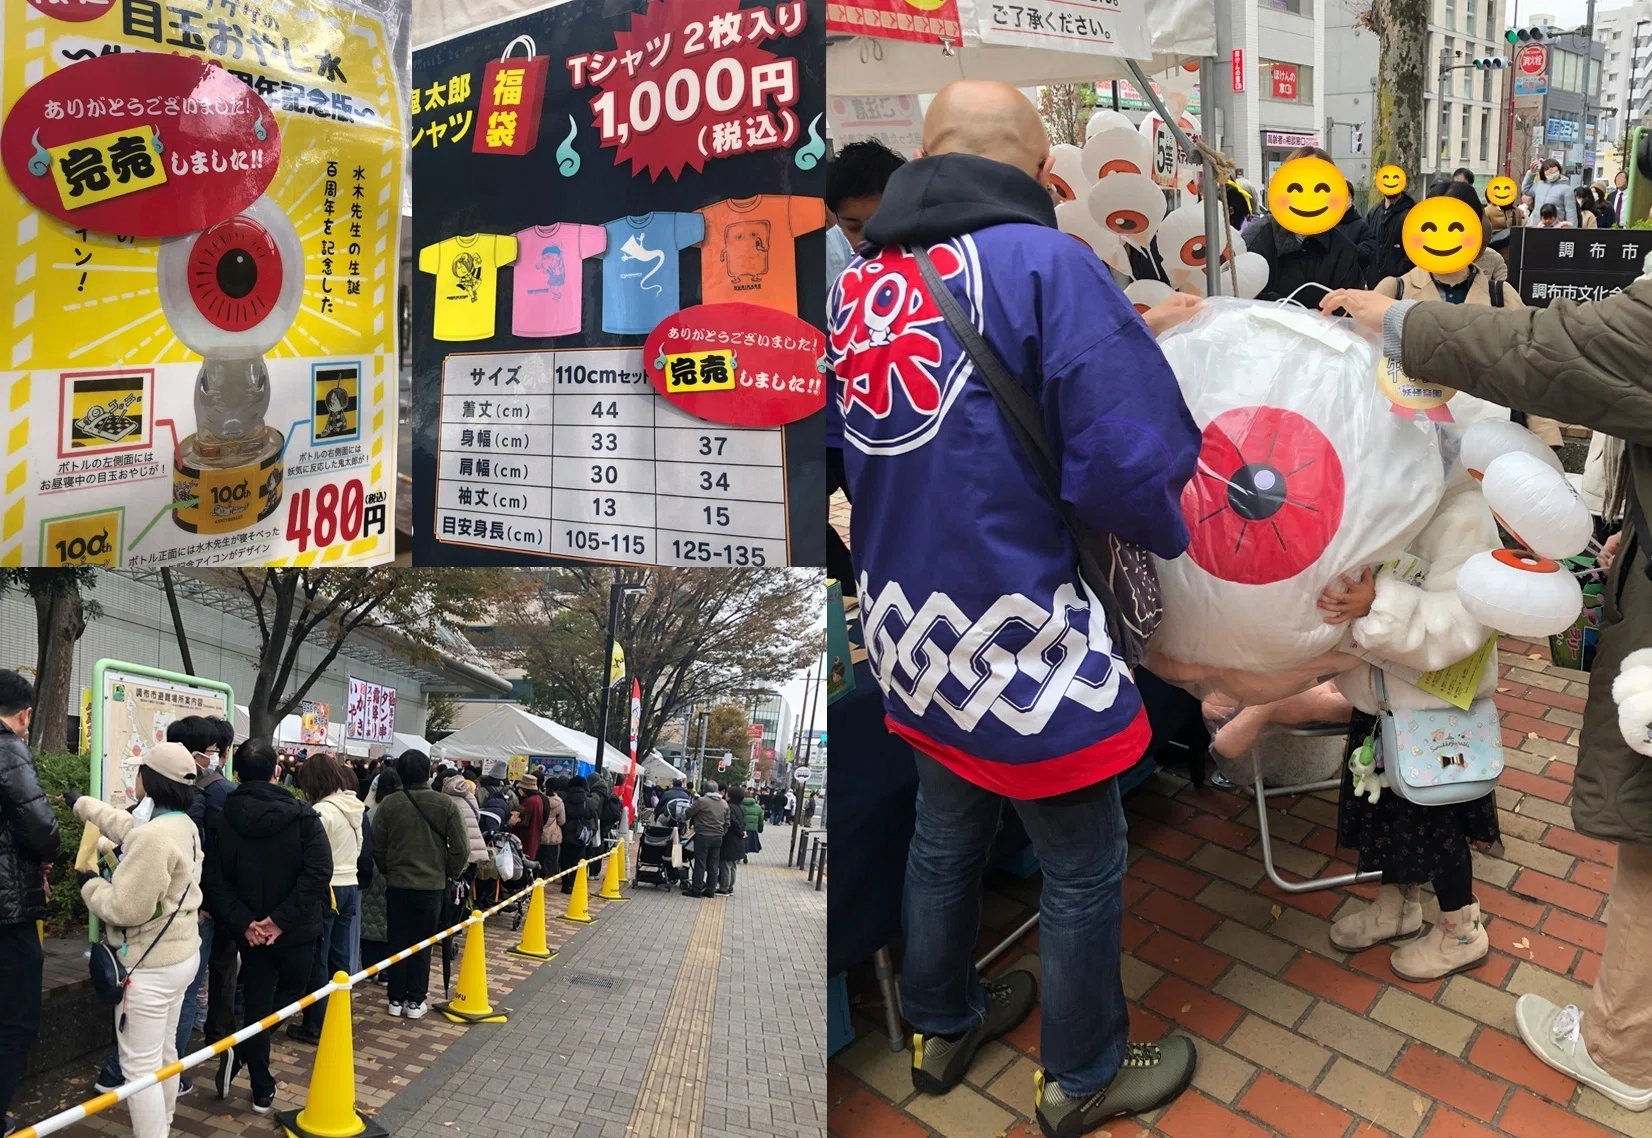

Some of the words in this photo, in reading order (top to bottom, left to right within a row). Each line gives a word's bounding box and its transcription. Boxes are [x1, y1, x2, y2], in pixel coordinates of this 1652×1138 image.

[992, 4, 1111, 39] ご了承ください。
[122, 0, 347, 84] 目玉おやじ水
[568, 32, 671, 85] Tシャツ
[683, 3, 802, 55] 2枚入り
[1273, 70, 1296, 82] ほけんの
[485, 68, 526, 148] 福袋
[592, 57, 795, 144] 1,000円
[697, 109, 795, 157] (税込)
[60, 136, 156, 197] 完売
[320, 161, 339, 313] 百周年を記念した
[347, 165, 366, 295] 水木先生の生誕
[1558, 241, 1639, 260] 調布市
[667, 326, 819, 351] ありがとうございました!
[470, 365, 523, 387] サイズ
[670, 354, 730, 387] 完売
[462, 400, 531, 419] 着丈(cm)
[591, 400, 619, 419] 44
[300, 445, 362, 461] ボトルの右側面には
[460, 429, 530, 449] 身幅(cm)
[591, 432, 618, 451] 33
[698, 436, 728, 456] 37
[40, 464, 166, 491] お昼寝中の目玉おやじが!
[58, 451, 154, 473] ボトルの左側面には
[459, 457, 529, 480] 肩幅(cm)
[590, 465, 618, 484] 30
[699, 471, 730, 492] 34
[458, 486, 528, 511] 袖丈(cm)
[592, 497, 617, 517] 13
[703, 505, 731, 526] 15
[442, 515, 544, 546] 目安身長(cm)
[565, 529, 646, 555] 105-115
[672, 539, 767, 567] 125-135
